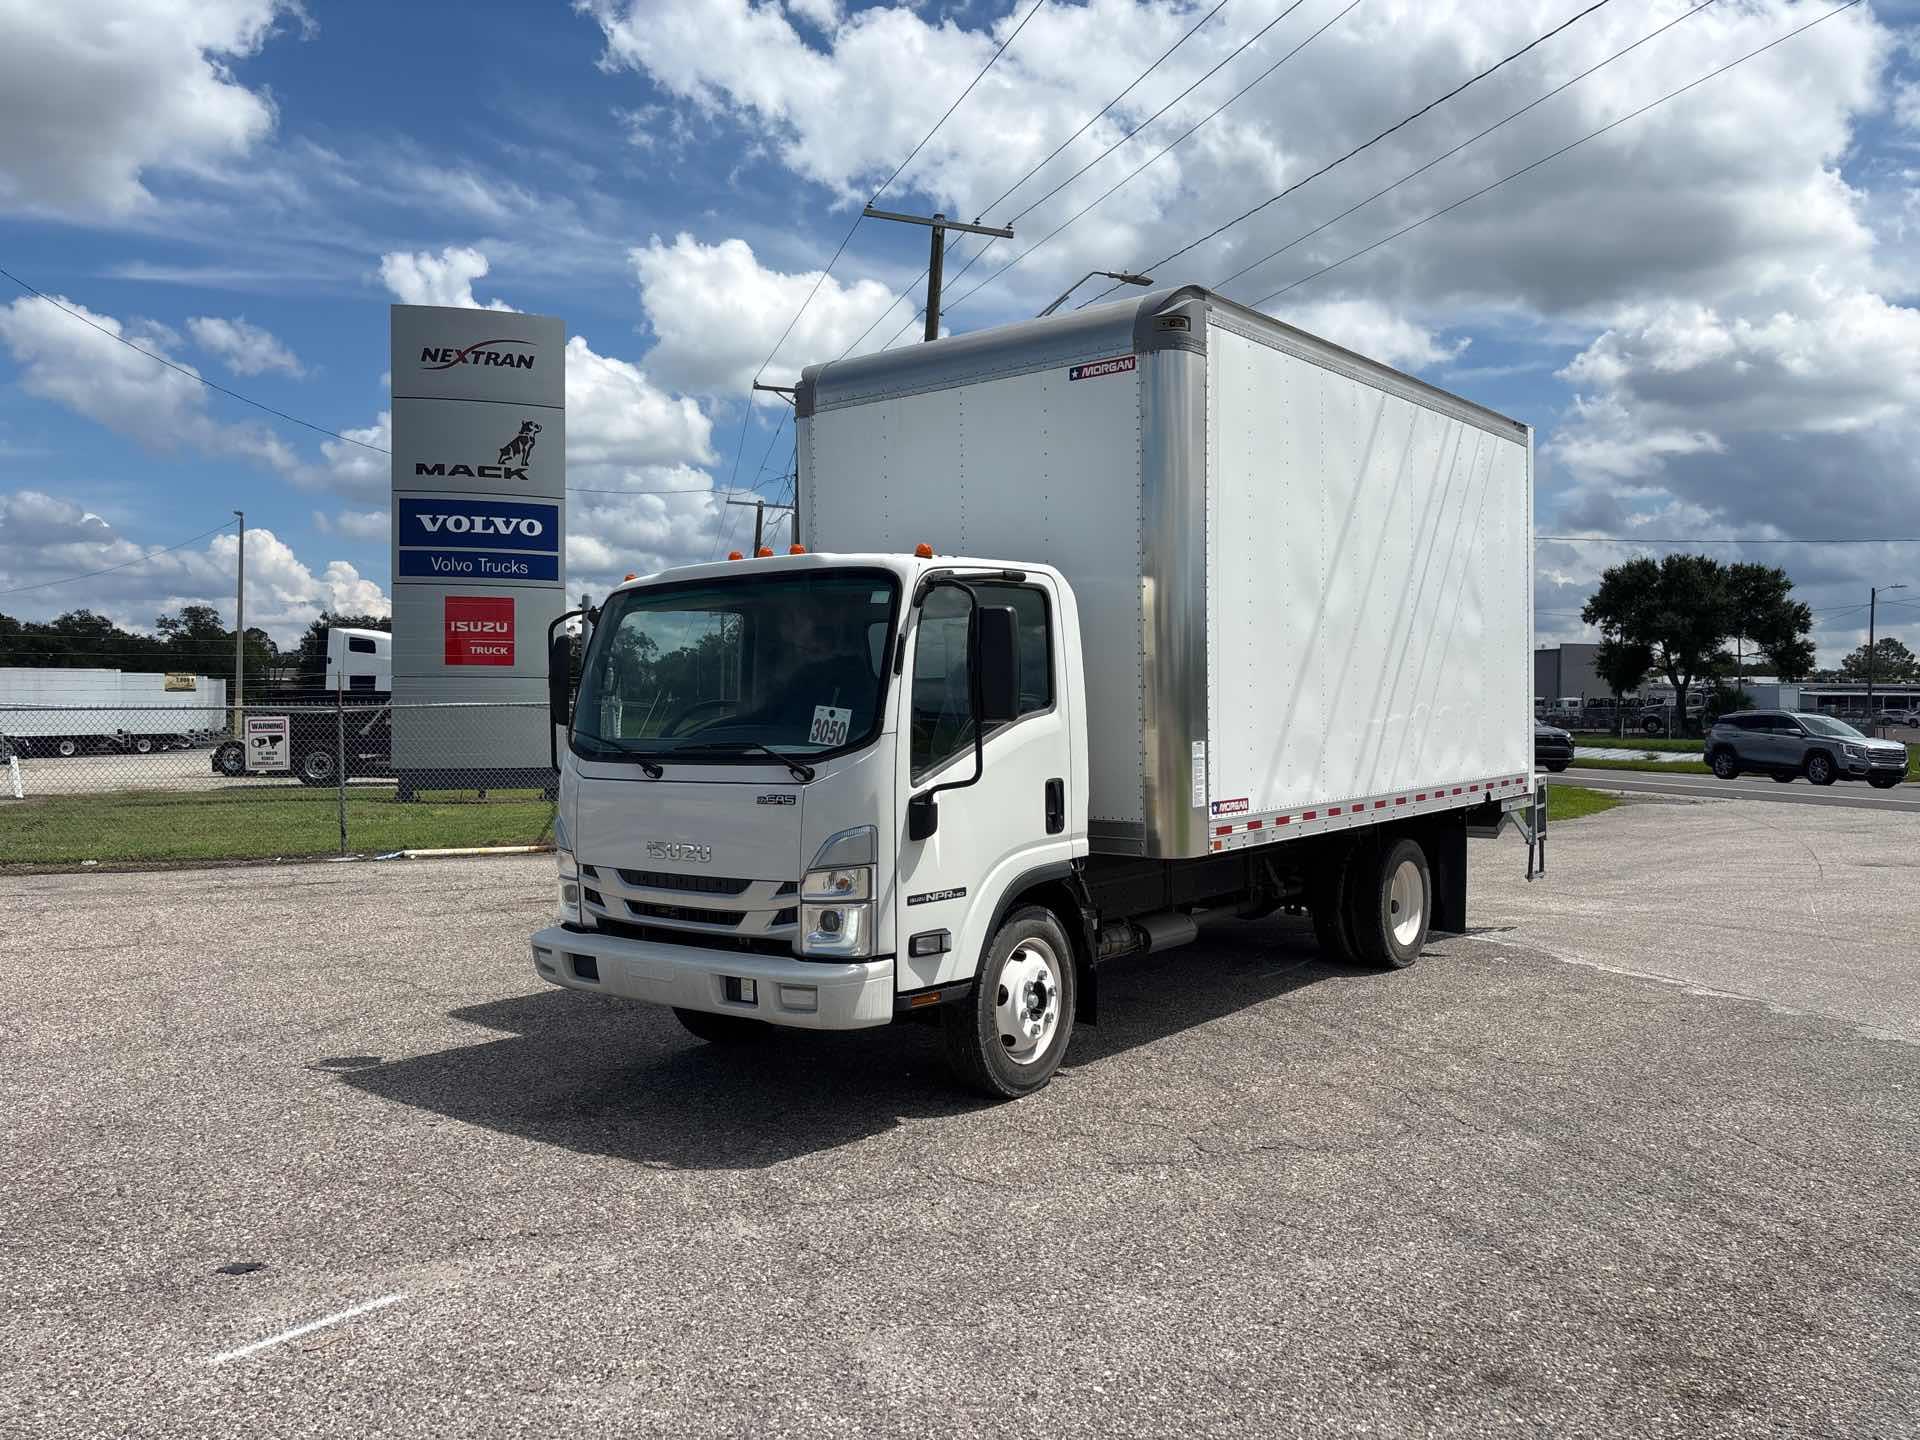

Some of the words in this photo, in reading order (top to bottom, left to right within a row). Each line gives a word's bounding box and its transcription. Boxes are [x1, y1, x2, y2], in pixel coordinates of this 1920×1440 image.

[420, 346, 535, 370] NEXTRAN
[1081, 359, 1134, 377] MORGAN
[415, 462, 529, 481] MACK
[416, 514, 543, 537] VOLVO
[431, 556, 473, 572] Volvo
[480, 558, 528, 575] Trucks
[450, 621, 508, 633] ISUZU
[470, 646, 508, 655] TRUCK
[251, 722, 283, 730] WARNING
[811, 718, 847, 745] 3050
[1219, 799, 1248, 812] MORGAN
[647, 841, 712, 864] ISUZU
[926, 891, 953, 902] NPR
